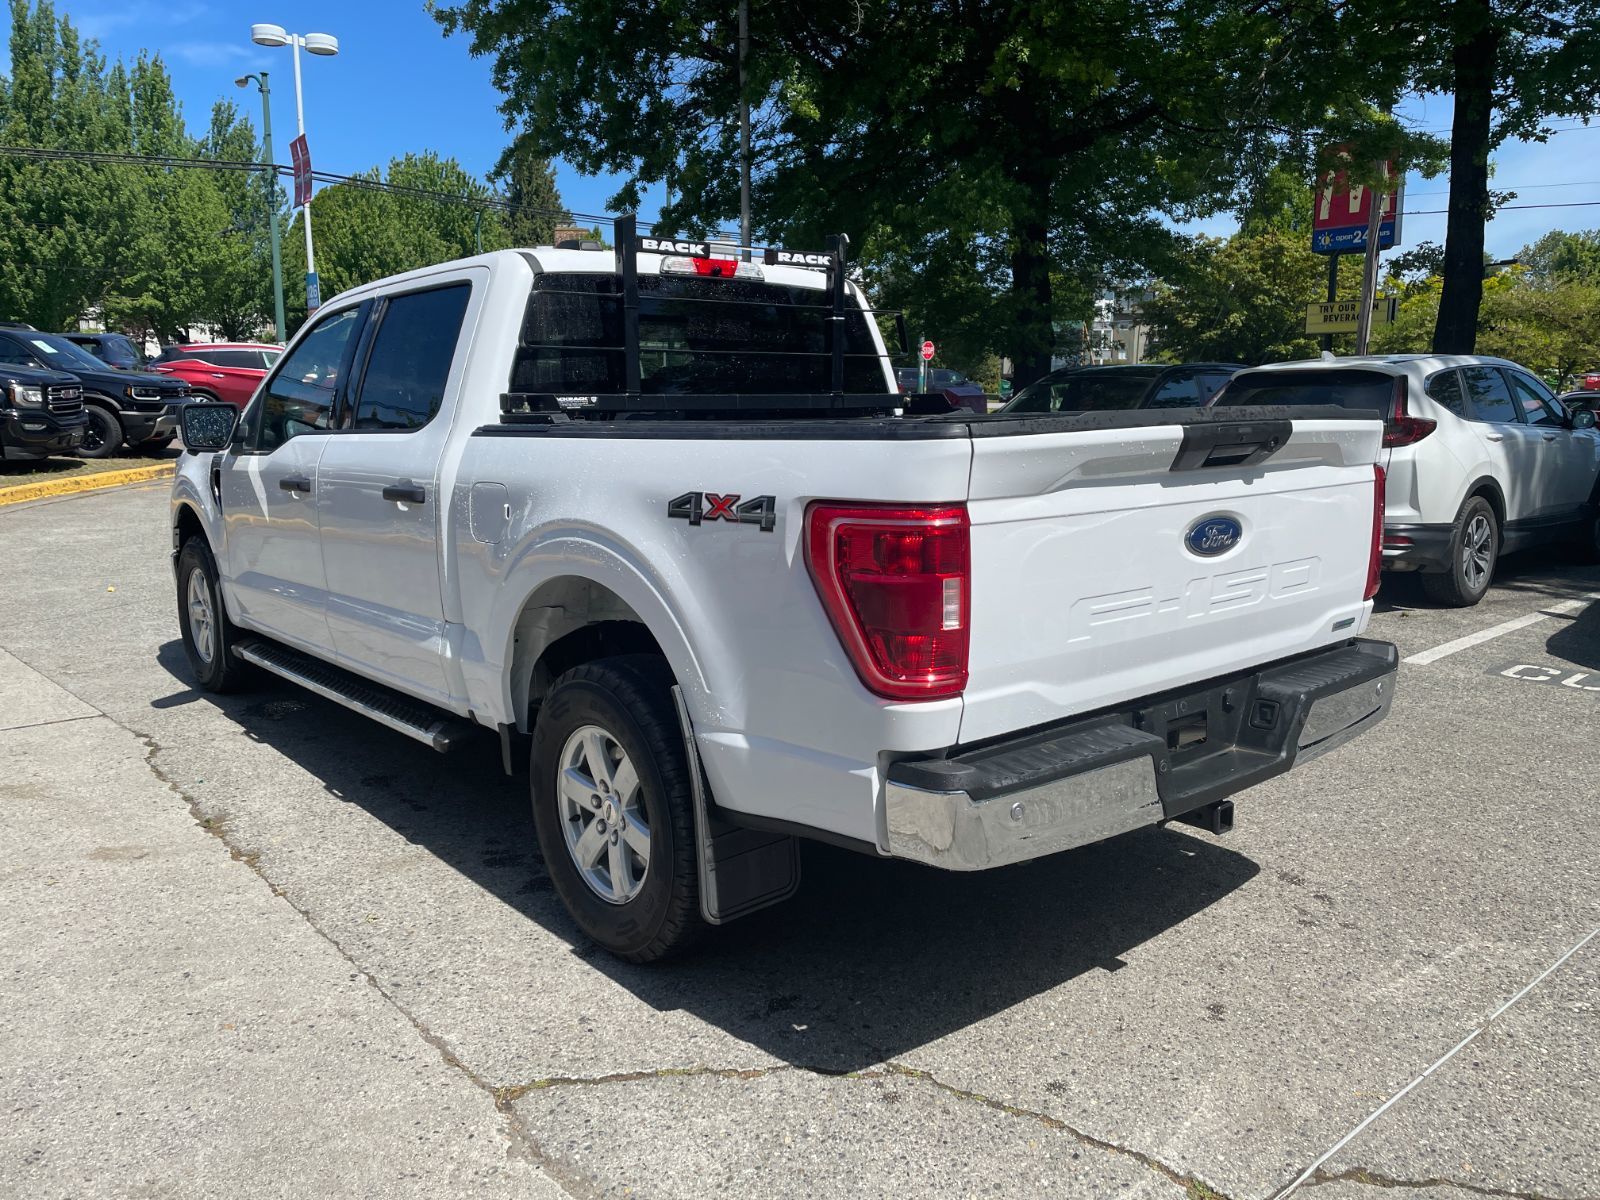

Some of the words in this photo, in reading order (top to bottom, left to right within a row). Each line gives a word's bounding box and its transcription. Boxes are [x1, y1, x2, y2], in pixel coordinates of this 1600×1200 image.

[1335, 234, 1353, 242] open
[642, 238, 704, 255] BACK
[778, 252, 832, 265] RACK
[1319, 304, 1335, 313] TRY
[1338, 303, 1356, 312] OUR
[1201, 524, 1233, 549] Ford
[1067, 555, 1322, 643] F-150
